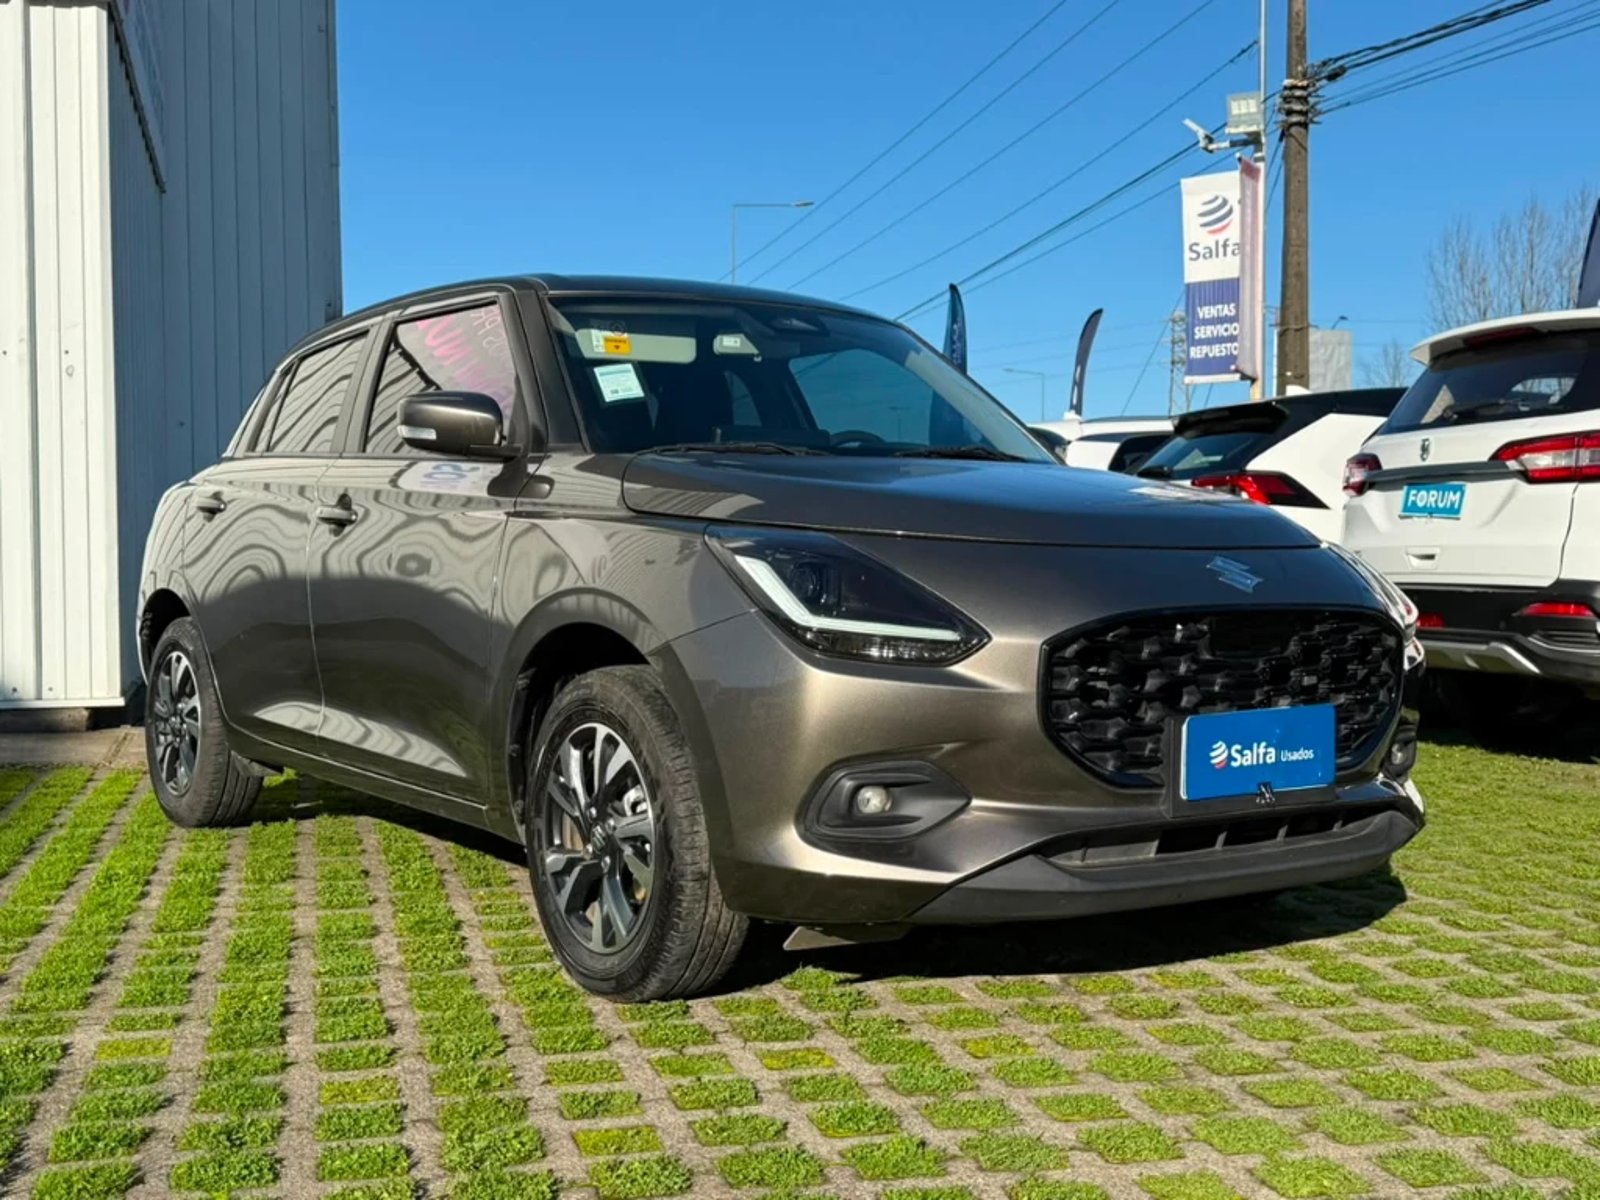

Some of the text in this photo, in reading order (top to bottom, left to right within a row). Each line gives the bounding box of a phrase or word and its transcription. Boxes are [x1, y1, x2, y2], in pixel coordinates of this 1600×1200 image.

[1188, 238, 1240, 261] Salfa
[1197, 303, 1236, 319] VENTAS
[1194, 323, 1239, 340] SERVICIO
[1407, 489, 1461, 509] FORUM
[1230, 741, 1315, 767] Salfa Usados
